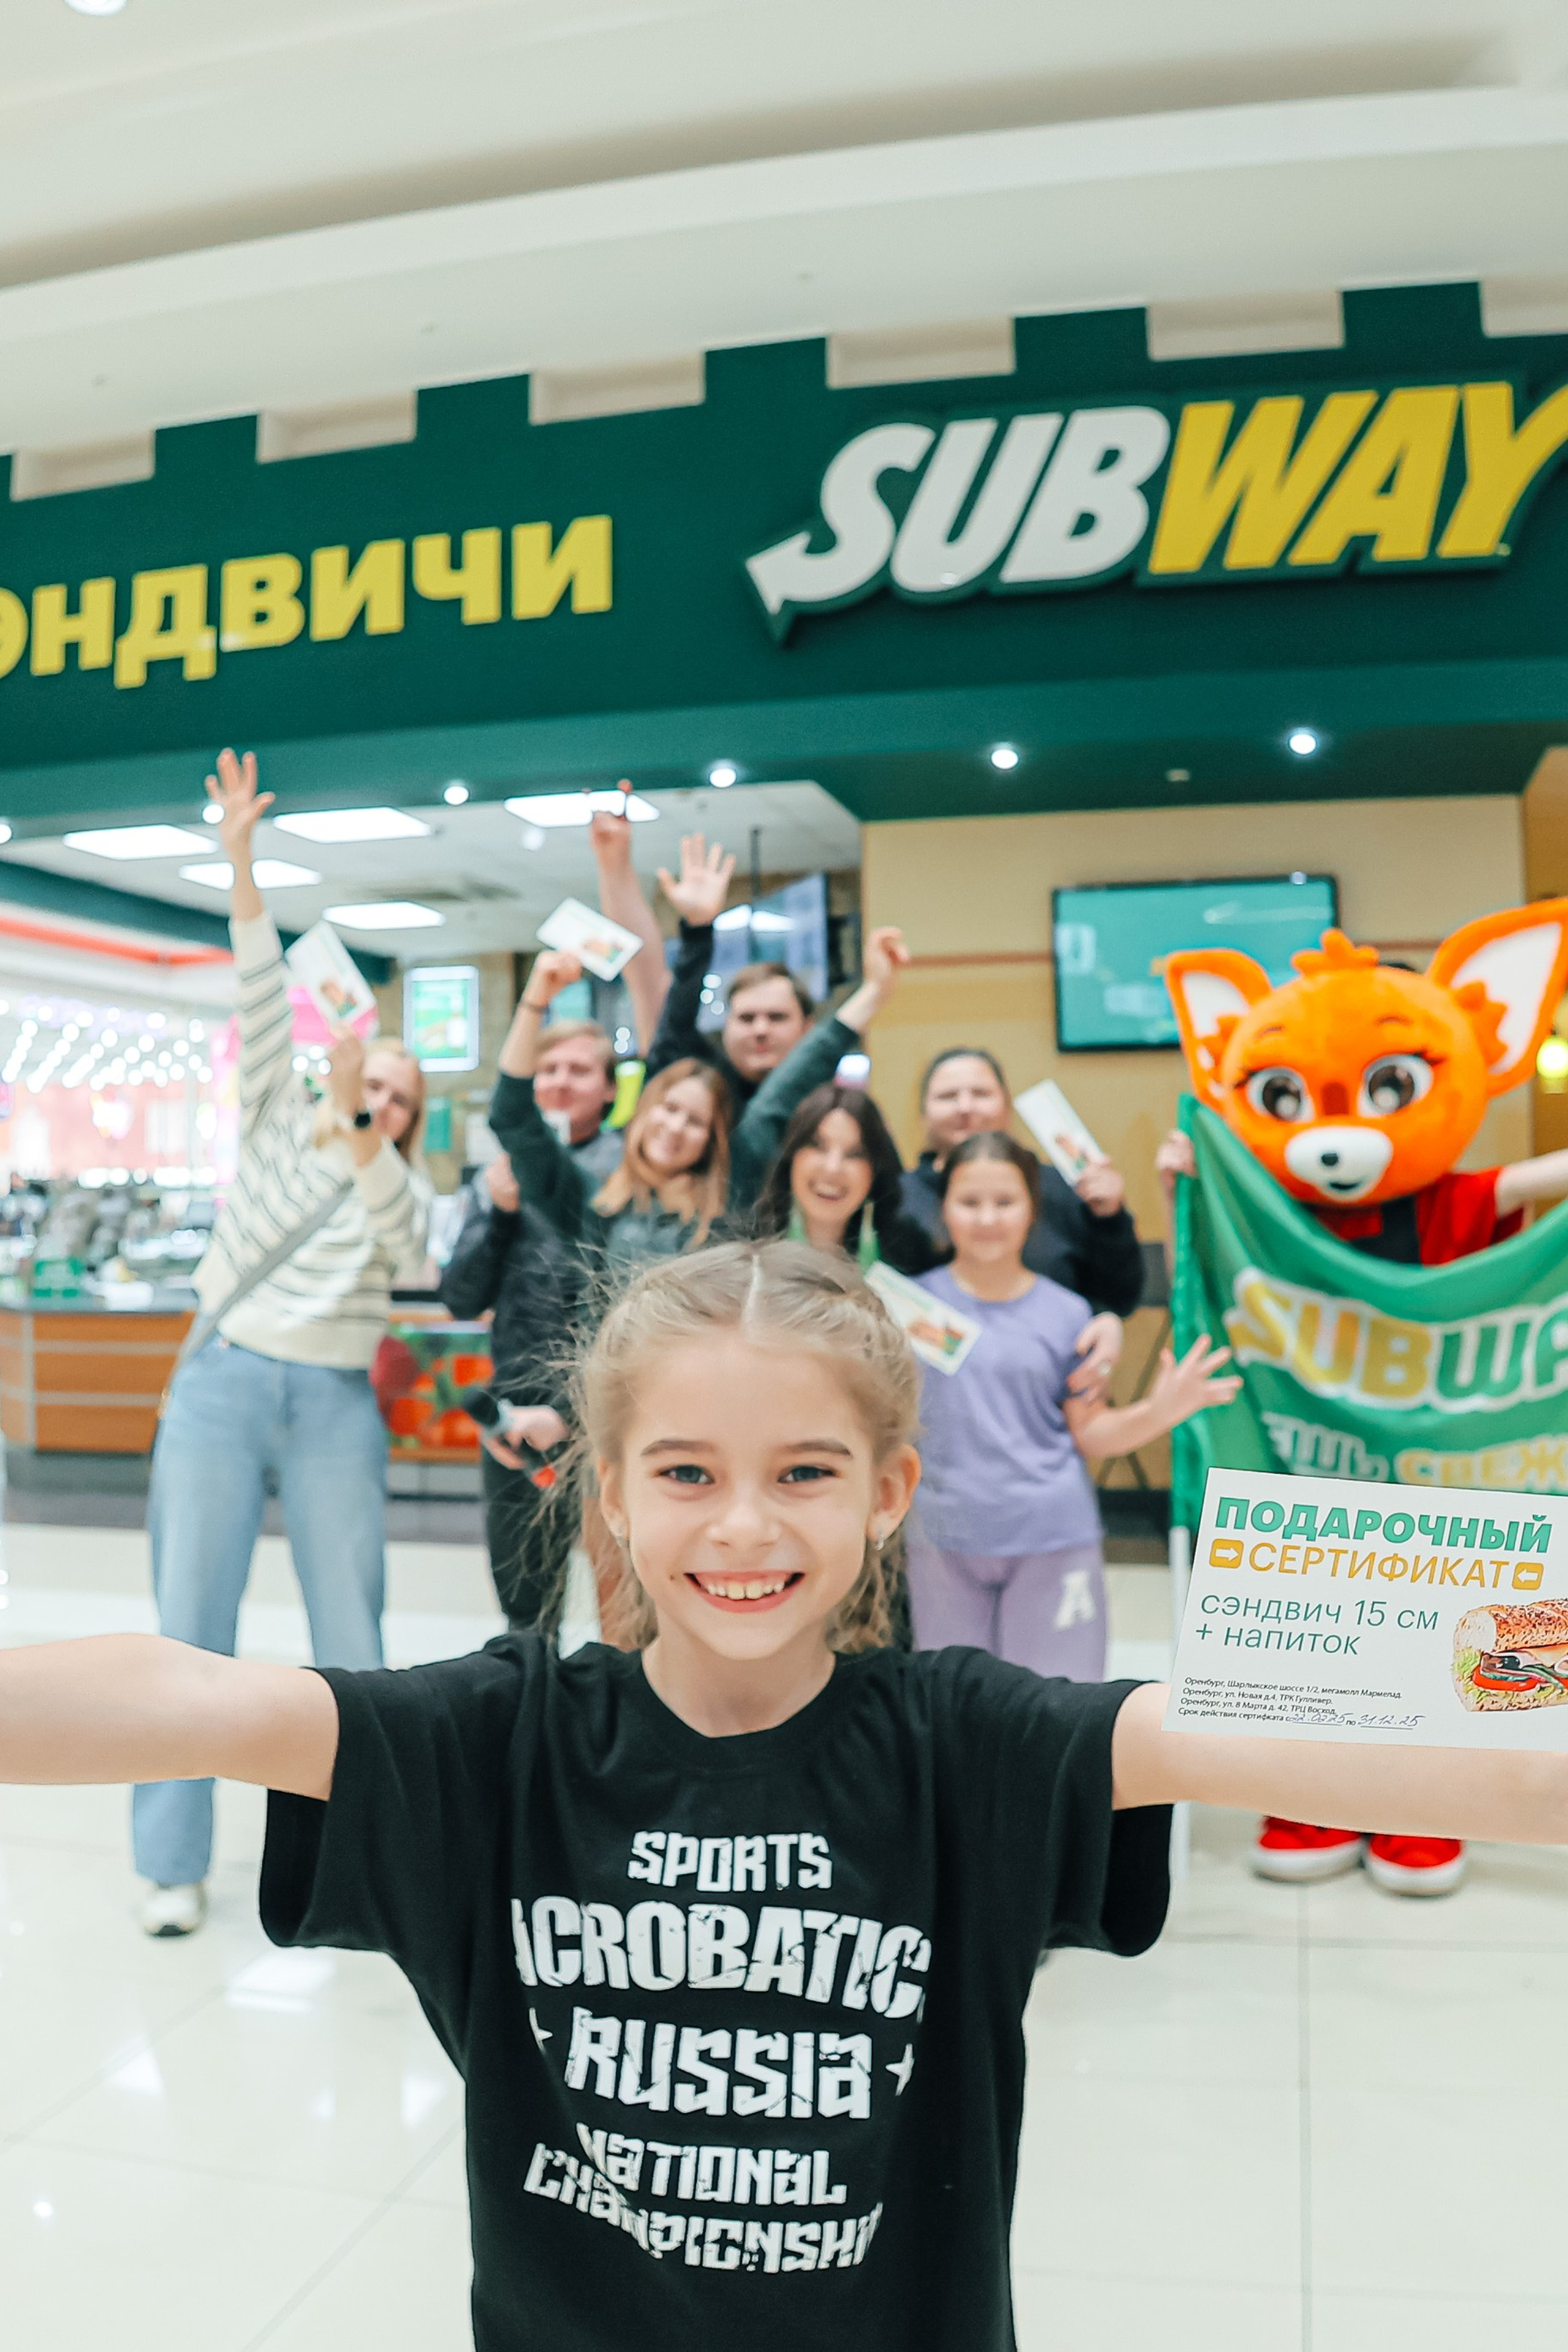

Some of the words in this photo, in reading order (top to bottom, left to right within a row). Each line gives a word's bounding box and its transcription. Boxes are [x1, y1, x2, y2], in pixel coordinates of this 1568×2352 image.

[745, 380, 1568, 614] SUBWAY
[1215, 1496, 1553, 1553] ПОДАРОЧНЫЙ
[1248, 1541, 1509, 1590] СЕРТИФИКАТ
[1354, 1599, 1387, 1627] 15
[1224, 1626, 1362, 1655] напиток
[1182, 1687, 1224, 1698] Оренбург,
[1295, 1695, 1333, 1705] Гулливер.
[1185, 1676, 1226, 1688] Оренбург,
[1227, 1680, 1278, 1691] Шарлыкское
[1178, 1707, 1199, 1716] Срок
[1199, 1709, 1237, 1718] действия
[1180, 1697, 1221, 1708] Оренбург,
[1242, 1702, 1267, 1710] Марта
[1291, 1705, 1306, 1713] ТРЦ
[627, 1830, 833, 1892] SPORTS
[510, 1894, 932, 2021] CROBATIC
